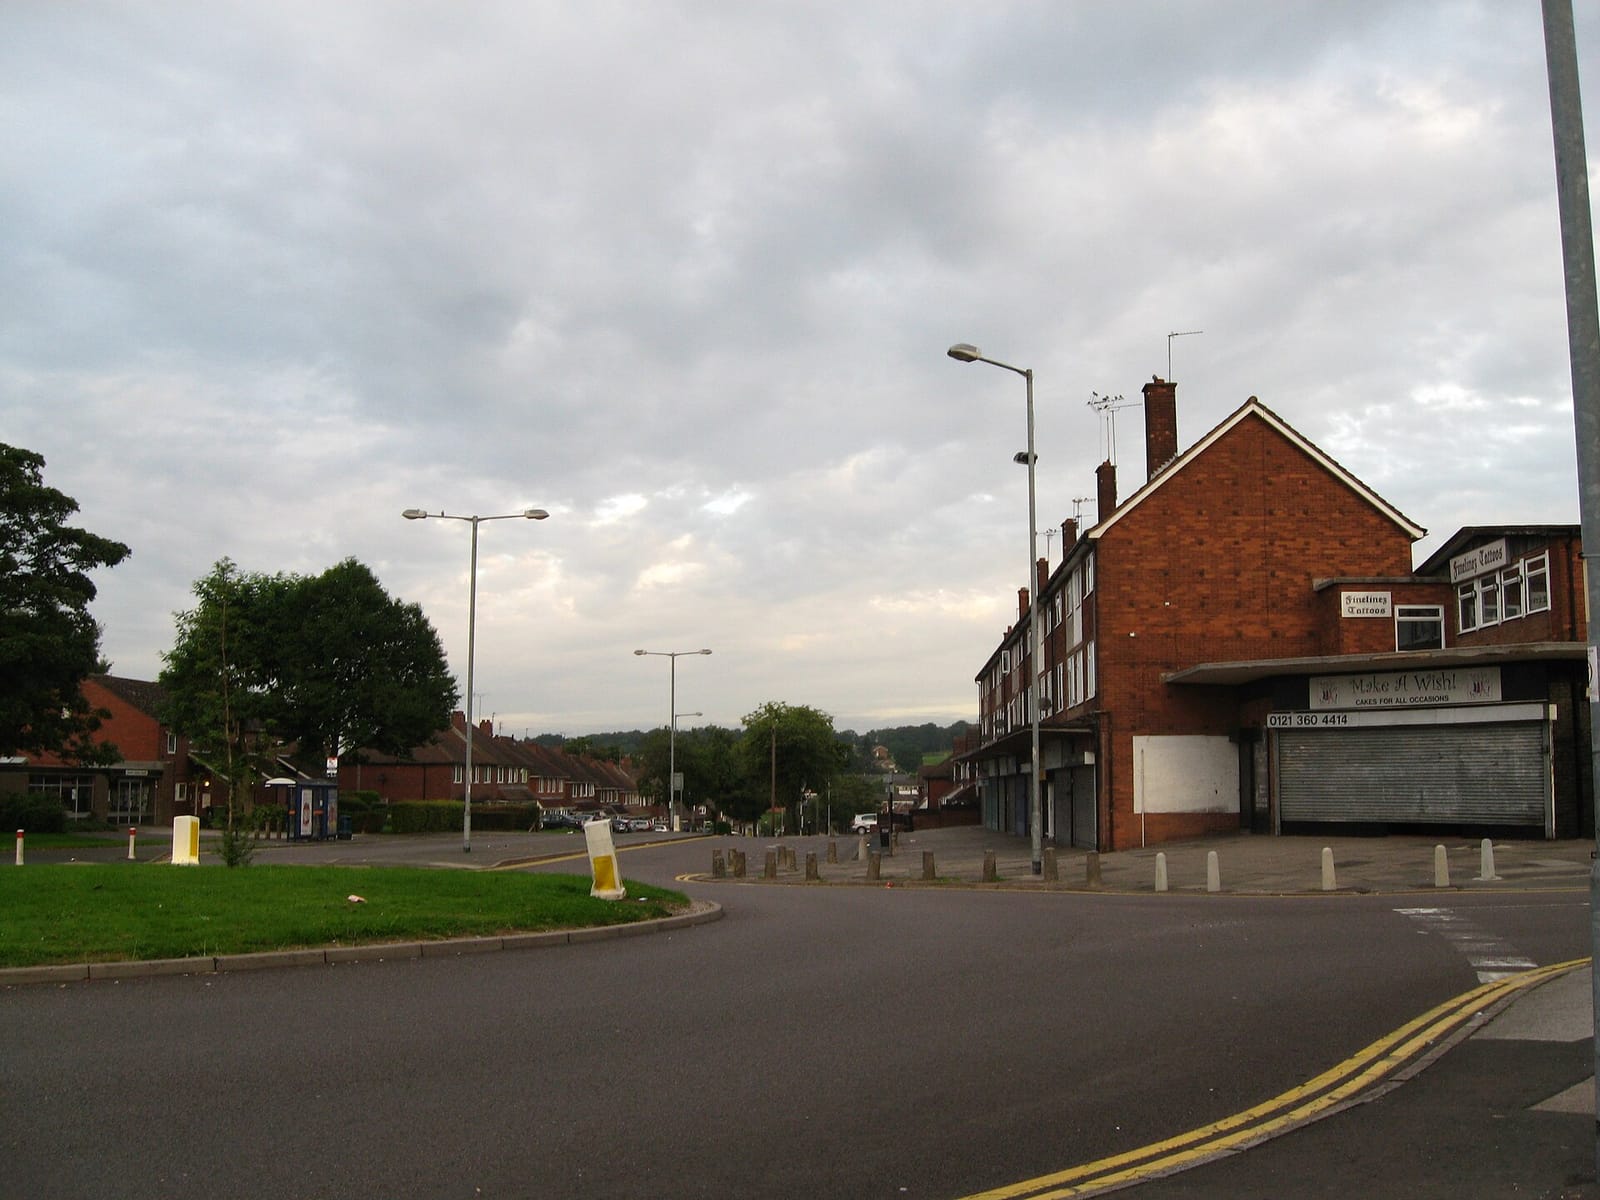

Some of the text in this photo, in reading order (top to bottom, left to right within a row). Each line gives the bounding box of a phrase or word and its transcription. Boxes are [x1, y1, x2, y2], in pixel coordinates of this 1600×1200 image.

[1479, 548, 1503, 567] Tattoos
[1345, 595, 1388, 605] Finelinez
[1347, 606, 1386, 615] Tattoos
[1350, 672, 1457, 694] Make A Wish!
[1355, 694, 1449, 706] CAKES FOR ALL OCCASIONS
[1269, 714, 1348, 726] 0121 360 4414
